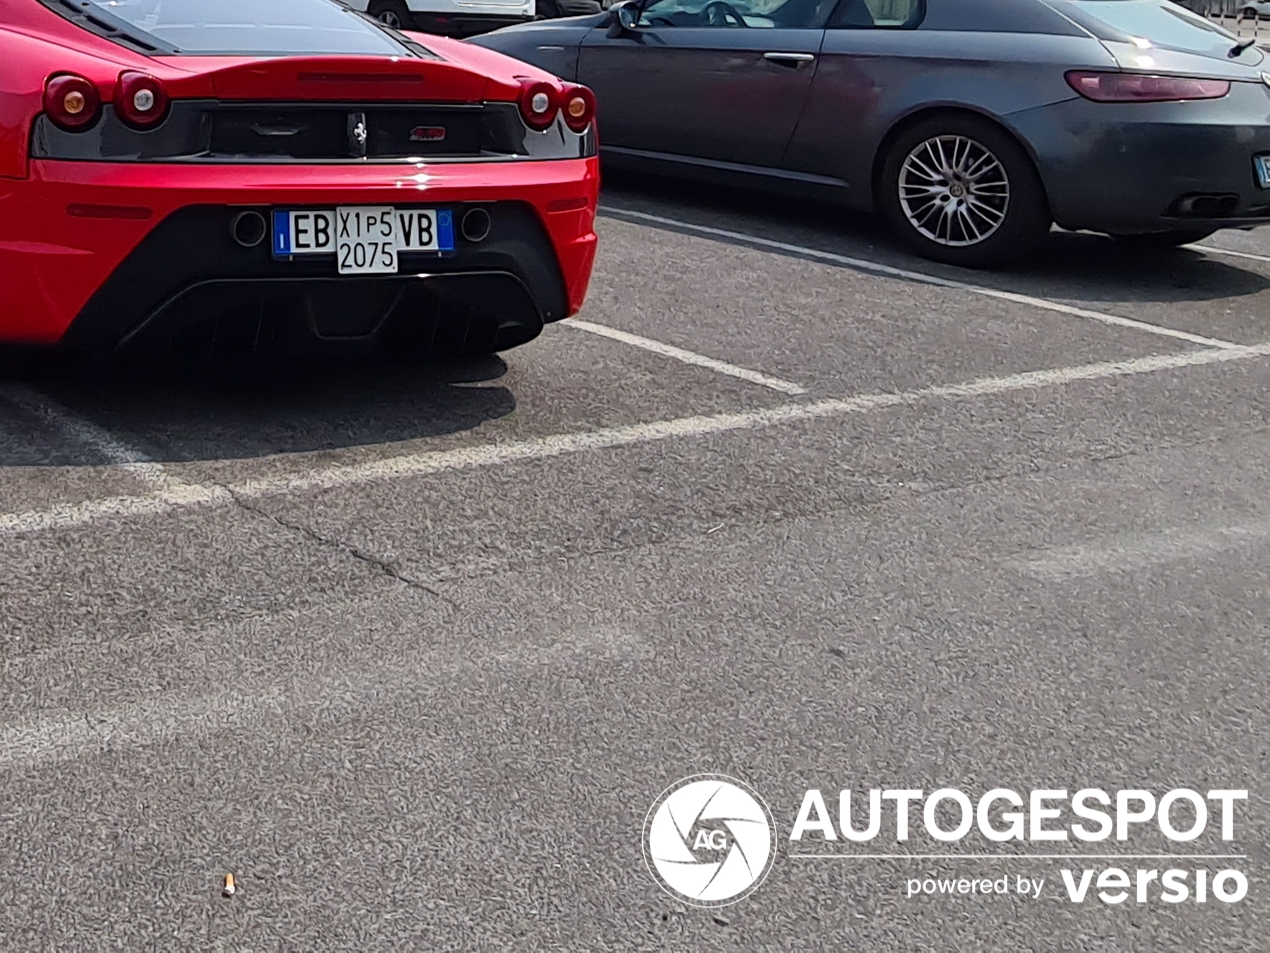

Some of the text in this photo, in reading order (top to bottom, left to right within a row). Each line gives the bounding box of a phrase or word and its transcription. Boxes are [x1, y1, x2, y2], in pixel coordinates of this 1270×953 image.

[294, 213, 330, 248] EB
[399, 213, 433, 247] VB
[339, 242, 394, 268] 2075
